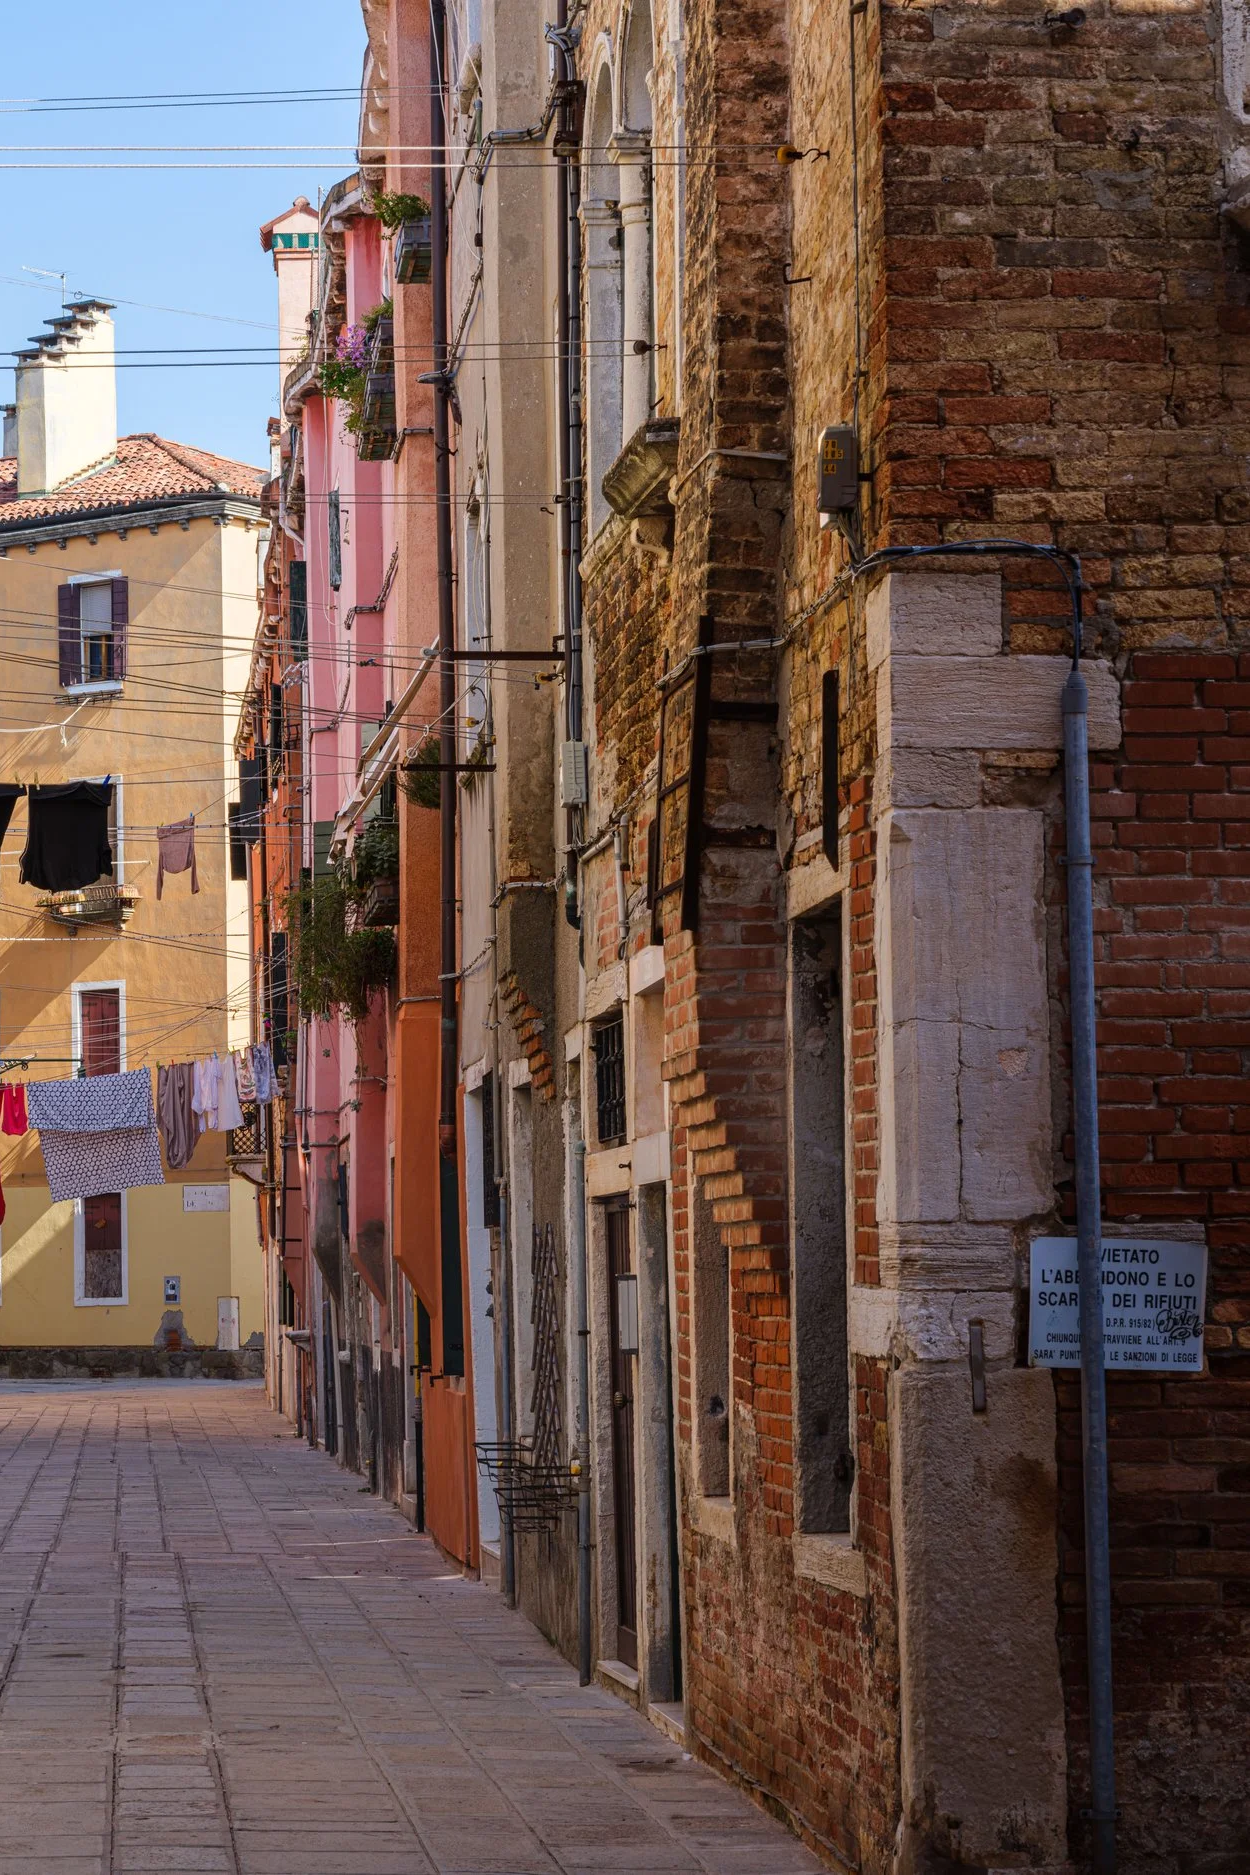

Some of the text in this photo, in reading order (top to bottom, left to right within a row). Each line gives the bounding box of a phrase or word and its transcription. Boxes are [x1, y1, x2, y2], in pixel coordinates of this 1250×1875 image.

[1100, 1248, 1159, 1264] VIETATO
[1042, 1269, 1195, 1288] L'ABDONO E LO
[1038, 1291, 1196, 1310] SCAR DEI RIFIUTI
[1106, 1319, 1126, 1328] D.P.R.
[1103, 1334, 1142, 1345] TRAVVIENE
[1034, 1349, 1055, 1360] SARA'
[1060, 1350, 1081, 1361] PUNIT
[1110, 1352, 1119, 1361] LE
[1123, 1352, 1157, 1363] SANZIONI
[1161, 1353, 1169, 1363] DI
[1173, 1353, 1197, 1363] LEGGE
